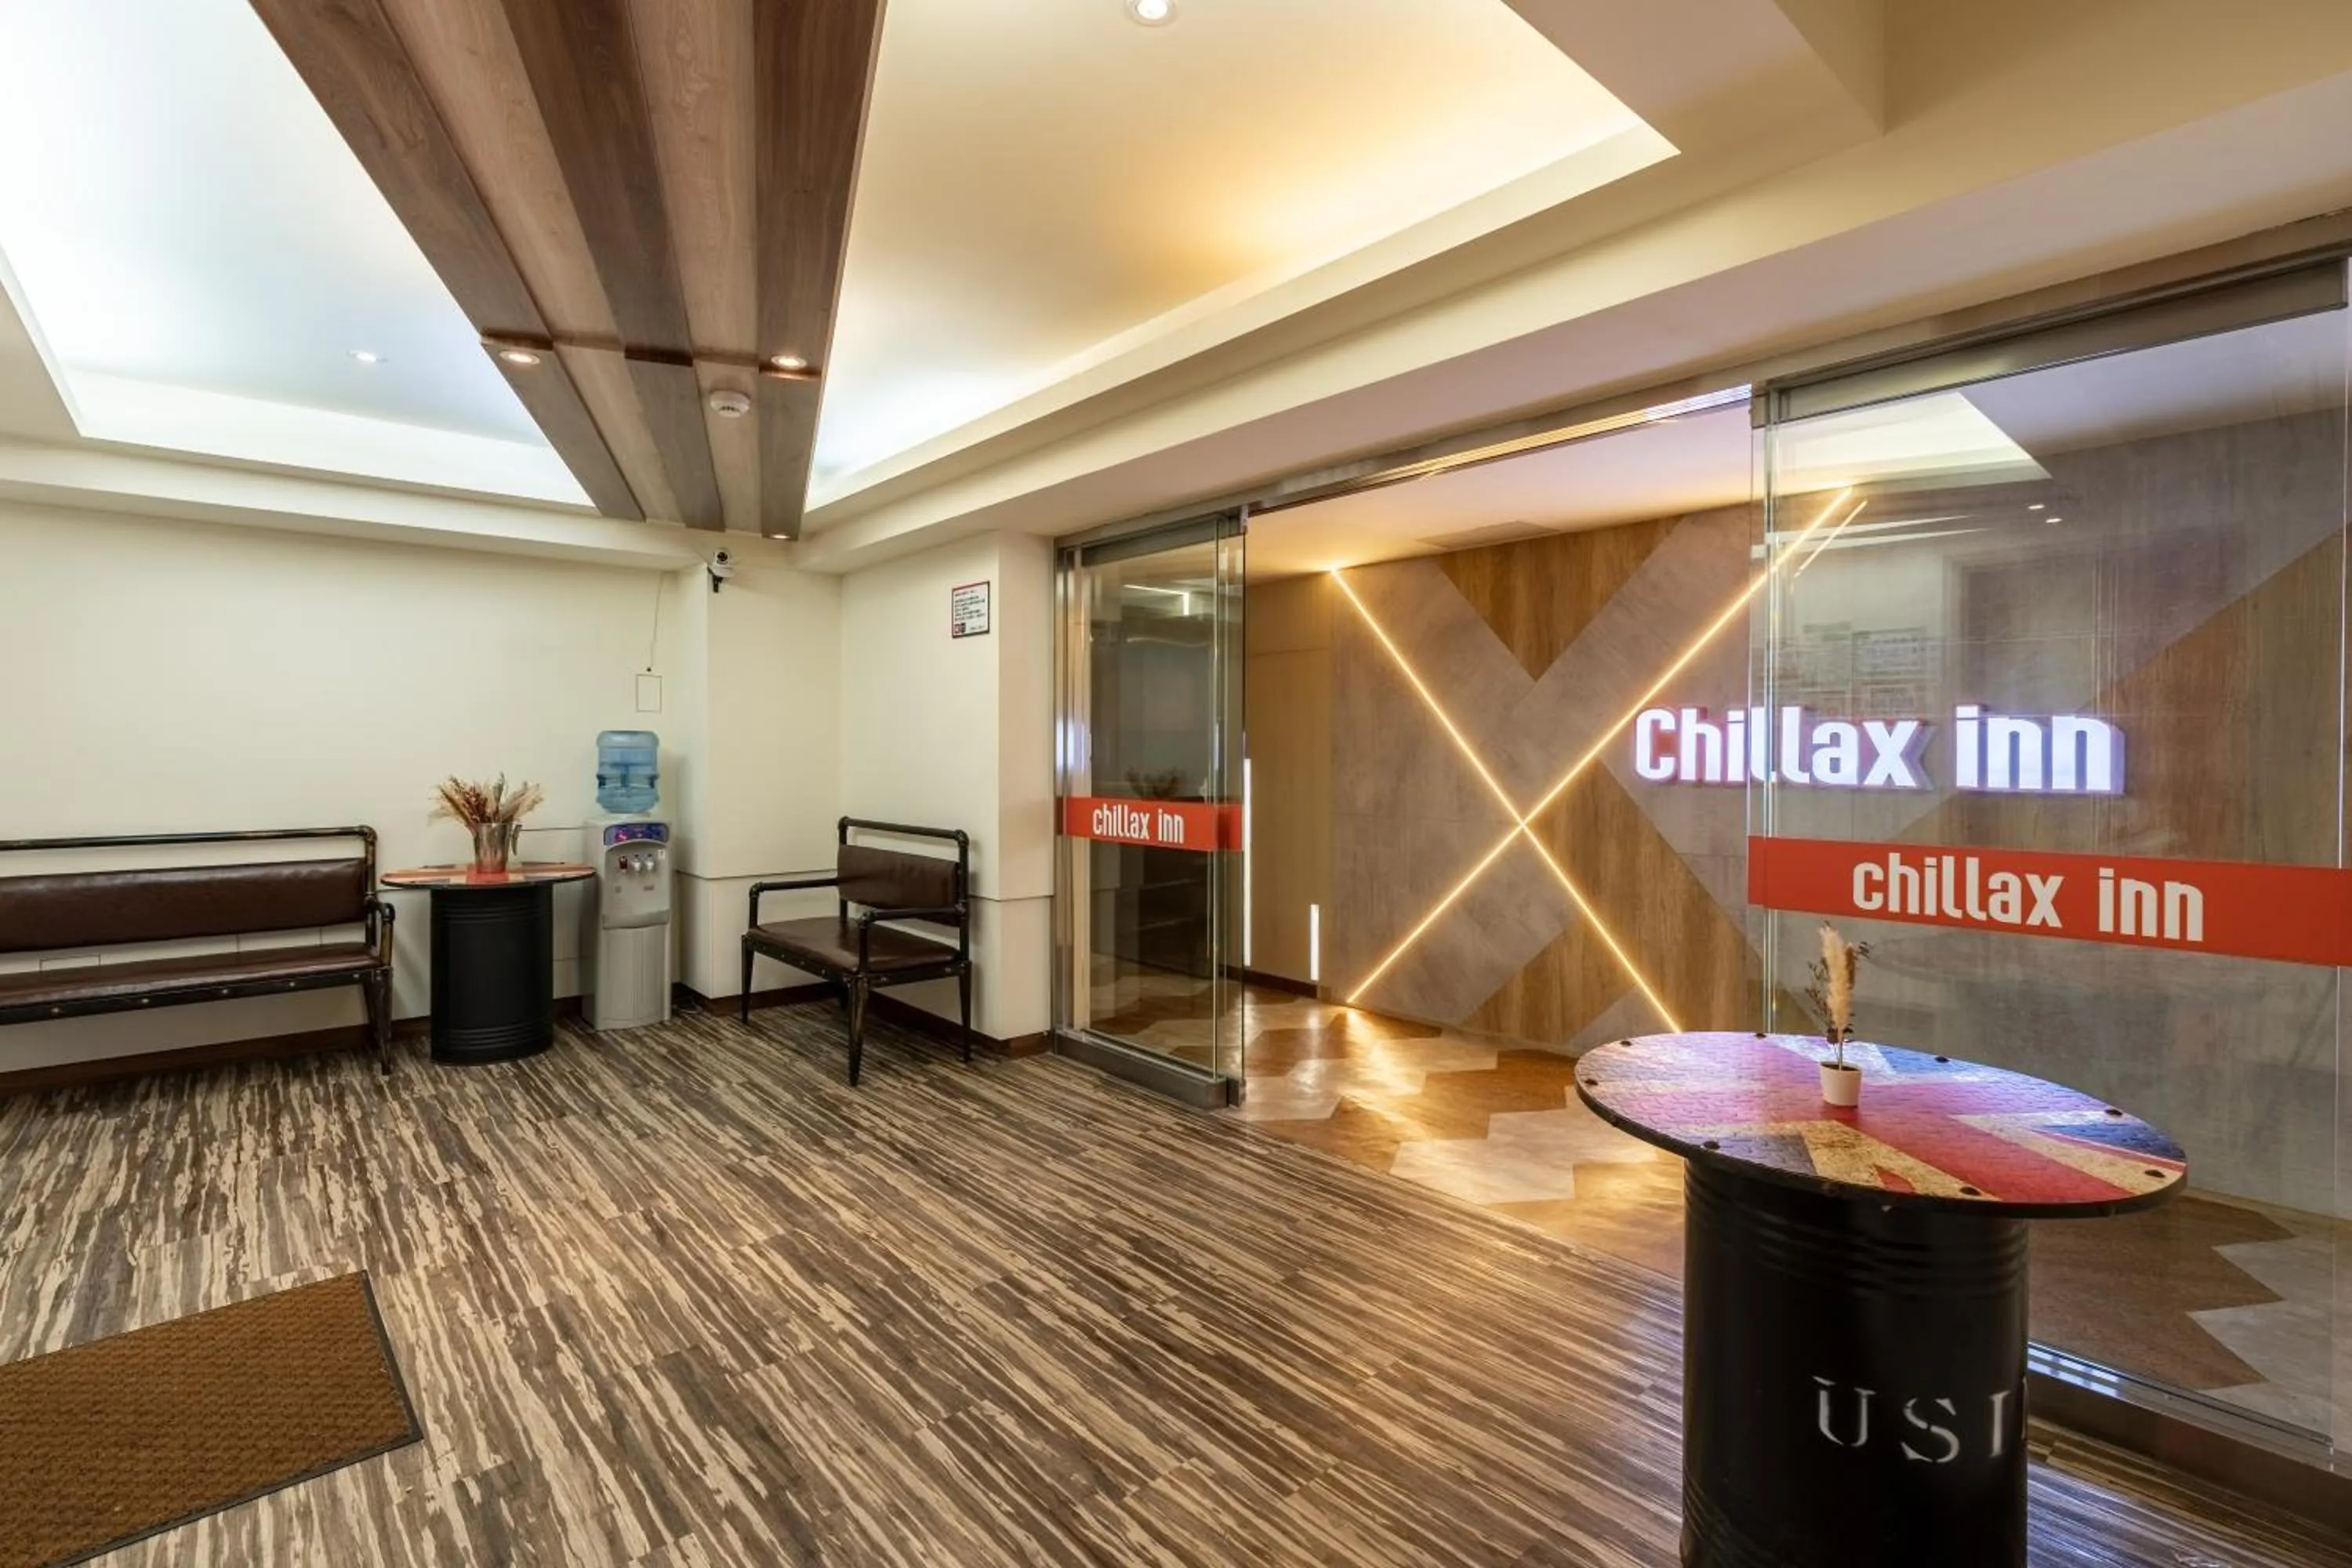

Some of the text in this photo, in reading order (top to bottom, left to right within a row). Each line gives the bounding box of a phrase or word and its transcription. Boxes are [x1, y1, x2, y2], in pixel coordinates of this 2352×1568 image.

[1955, 704, 2115, 792] inn
[1092, 803, 1185, 844] chillax inn
[1852, 852, 2204, 942] chillax inn
[1812, 1375, 2027, 1464] USI
